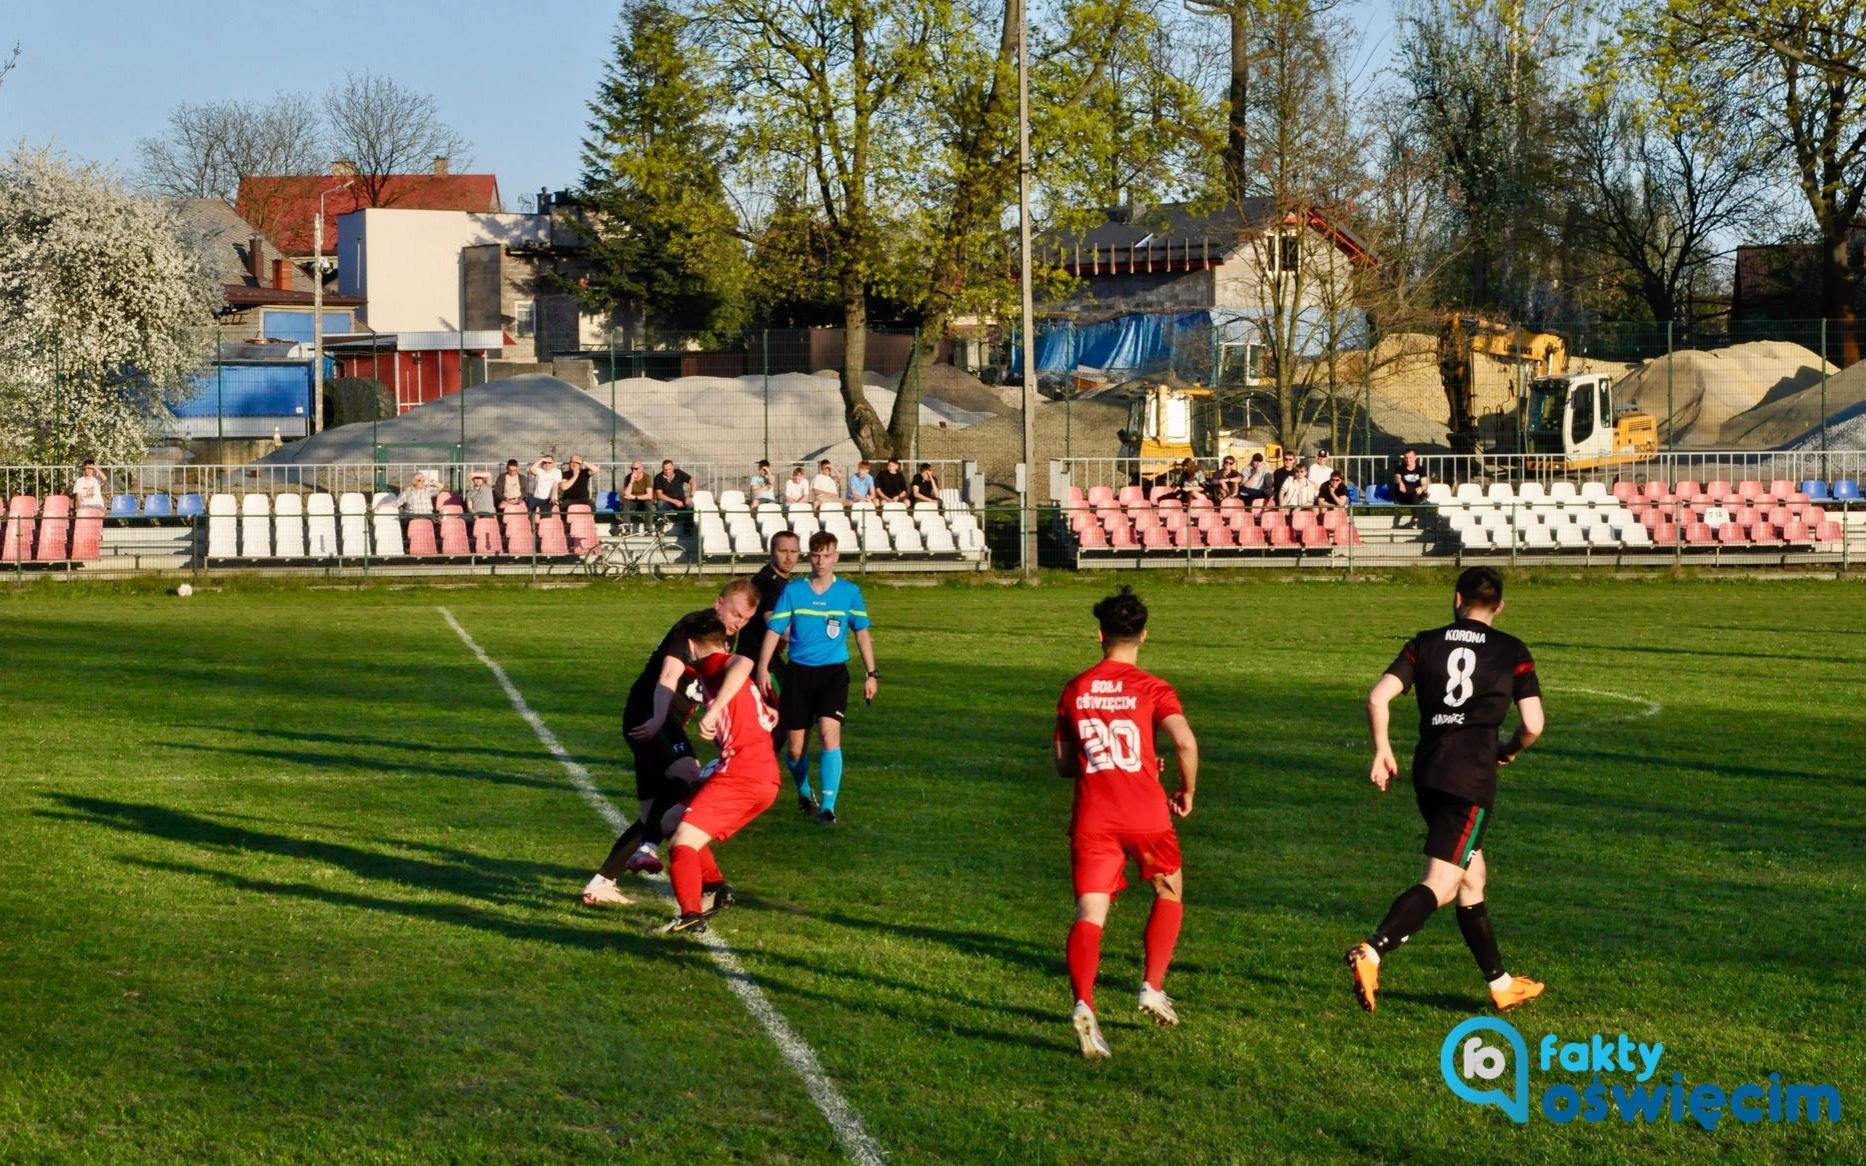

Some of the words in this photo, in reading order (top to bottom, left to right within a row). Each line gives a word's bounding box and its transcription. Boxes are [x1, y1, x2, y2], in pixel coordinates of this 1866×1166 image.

[1444, 629, 1486, 643] KORONA
[1091, 680, 1123, 693] SOŁA
[1443, 647, 1476, 708] 8
[1076, 692, 1137, 713] OŚWIĘCIM
[1078, 718, 1142, 774] 20
